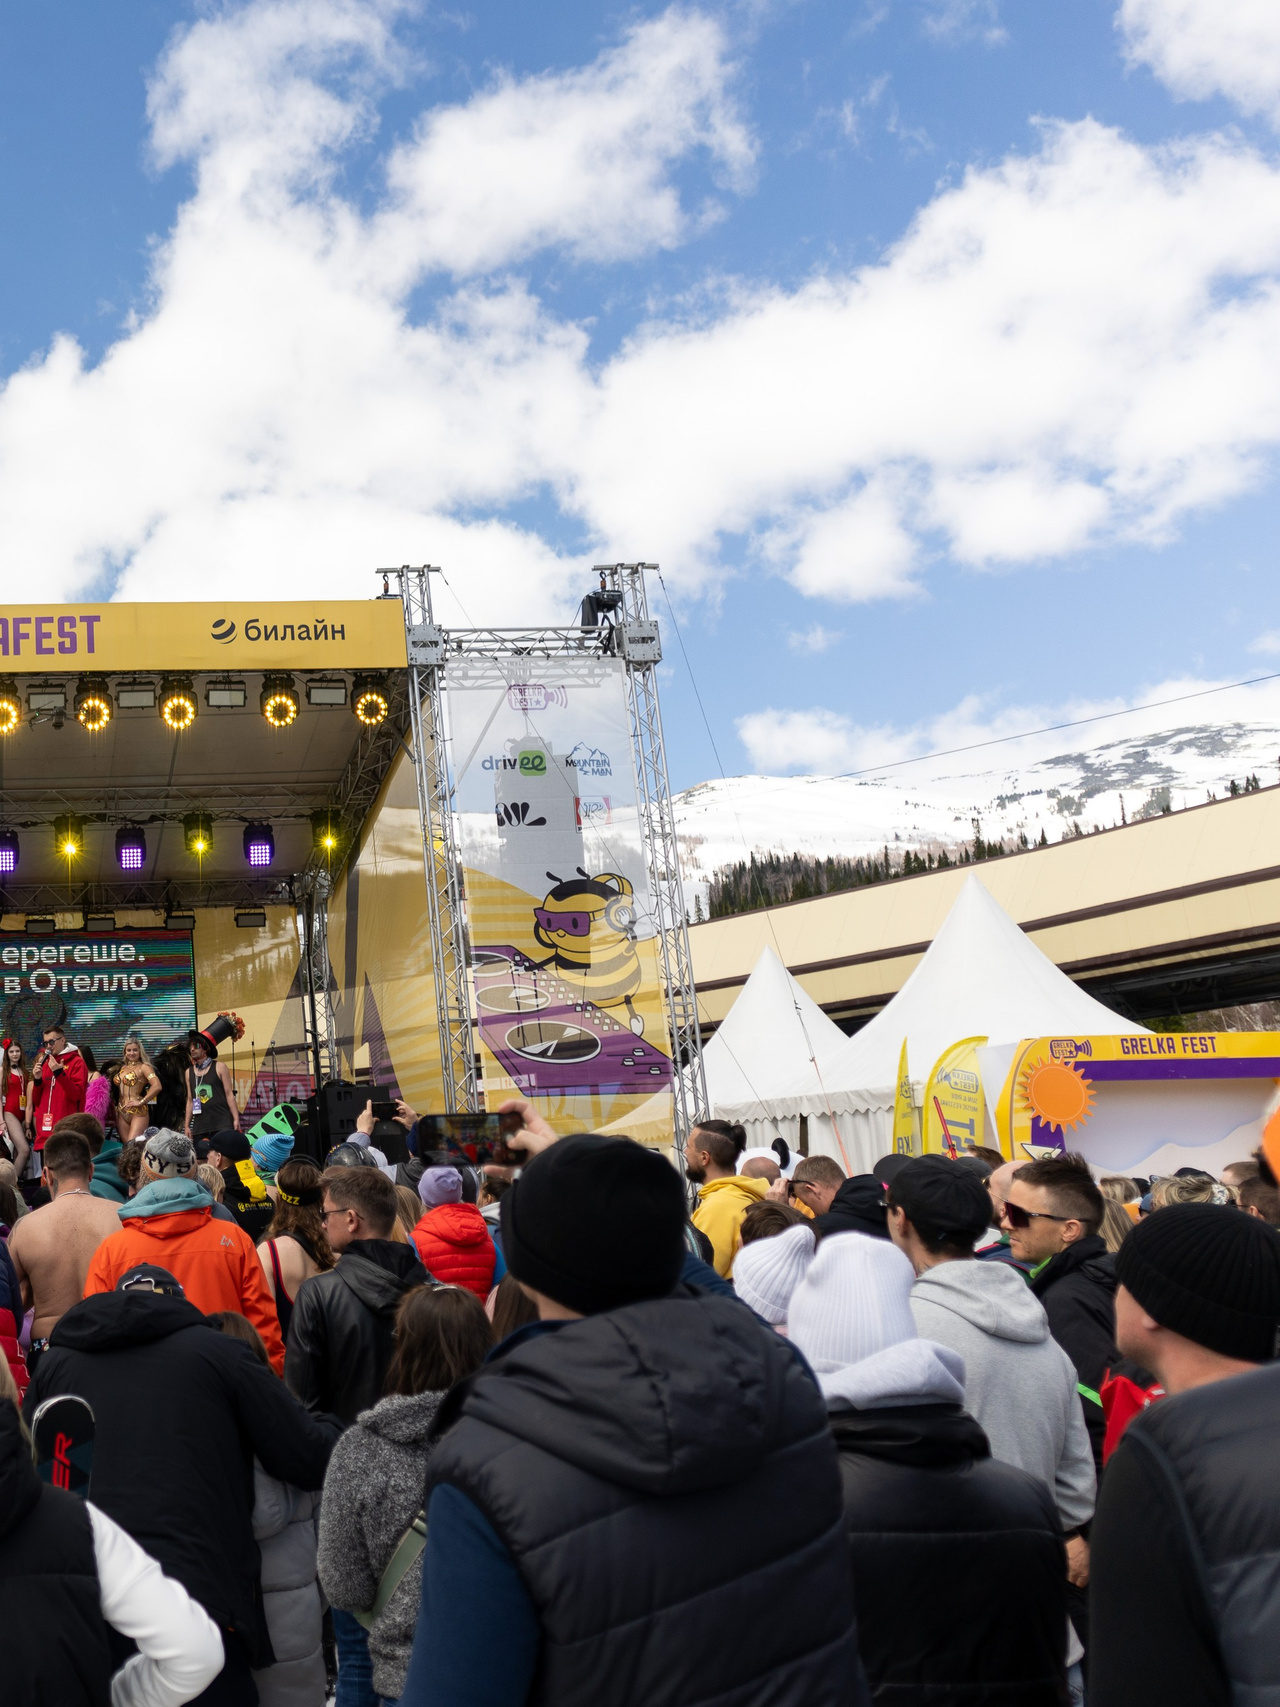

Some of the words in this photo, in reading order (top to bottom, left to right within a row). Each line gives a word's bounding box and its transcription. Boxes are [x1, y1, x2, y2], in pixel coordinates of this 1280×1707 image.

[244, 618, 346, 642] билайн
[481, 755, 547, 772] drivee
[591, 768, 612, 776] MAN
[4, 976, 22, 994] в
[29, 968, 149, 994] Отелло
[1054, 1049, 1069, 1057] FEST
[1120, 1037, 1177, 1055] GRELKA
[1181, 1036, 1217, 1053] FEST
